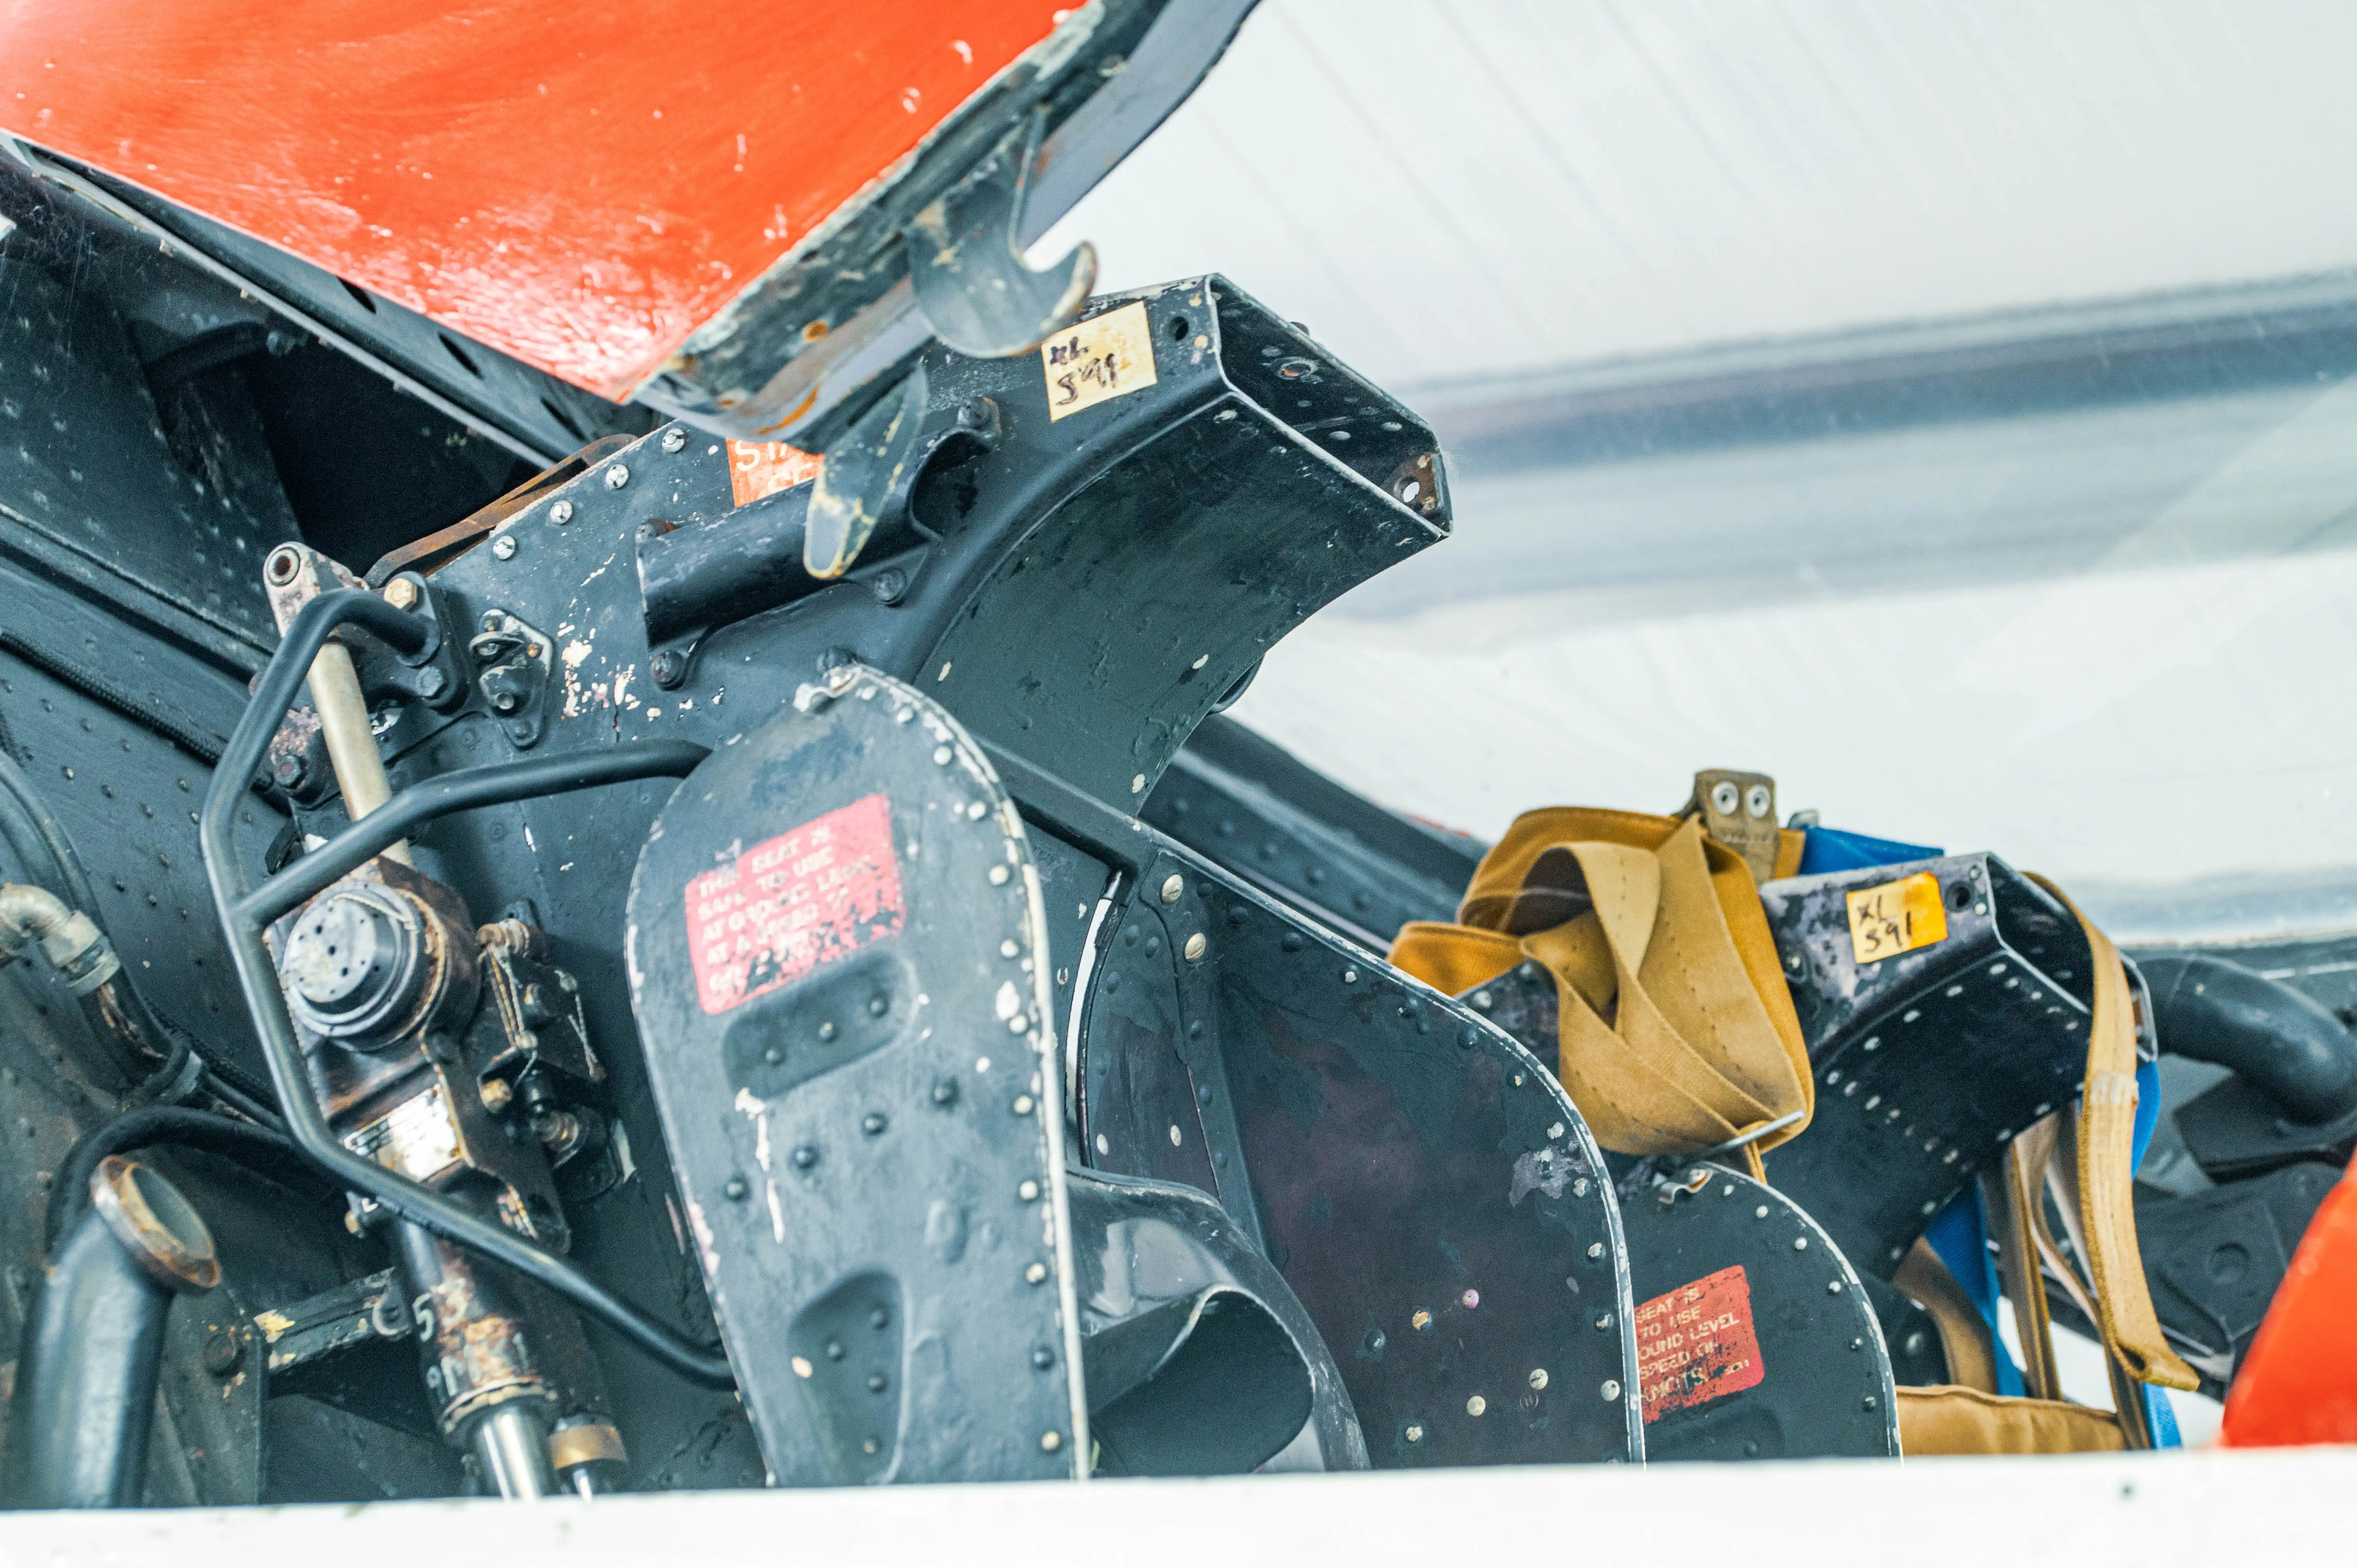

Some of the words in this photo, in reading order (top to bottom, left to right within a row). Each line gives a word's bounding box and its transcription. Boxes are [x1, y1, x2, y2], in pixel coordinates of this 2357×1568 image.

[752, 839, 800, 873] SEAT
[756, 870, 789, 892] TO
[793, 846, 835, 877] USE
[1856, 894, 1887, 927] XL
[1640, 1323, 1662, 1338] TO
[1669, 1305, 1701, 1328] USE
[1689, 1312, 1740, 1341] LEVEL
[1639, 1351, 1690, 1380] SPEED
